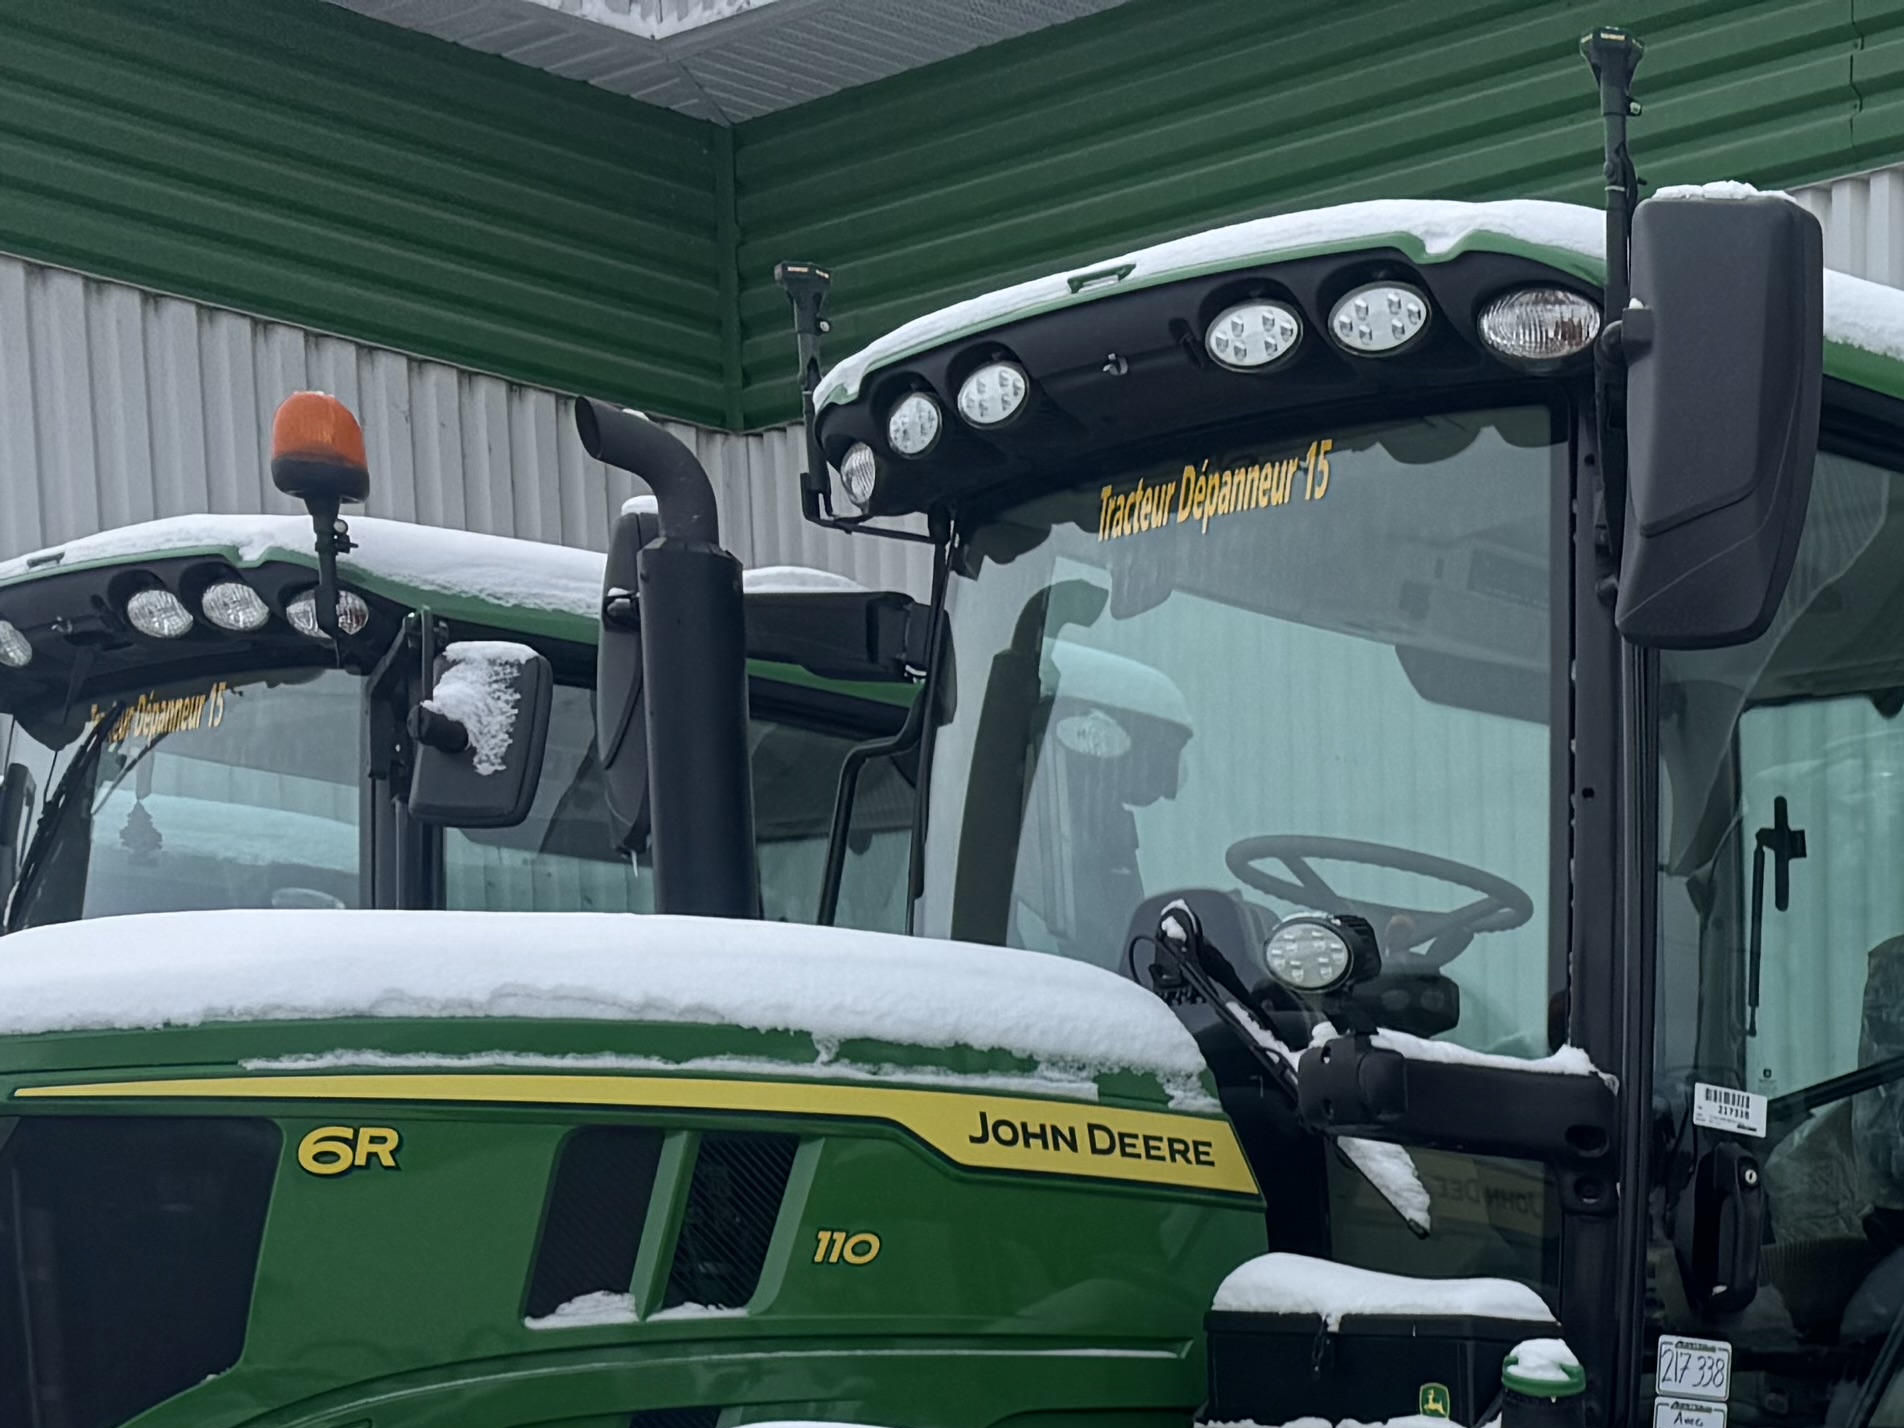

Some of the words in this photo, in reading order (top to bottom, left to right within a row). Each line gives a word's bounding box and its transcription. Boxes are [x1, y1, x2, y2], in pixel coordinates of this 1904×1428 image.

[1098, 478, 1177, 542] Tracteur
[1176, 458, 1298, 535] Dépanneur
[1305, 439, 1333, 500] 15
[208, 682, 227, 728] 15
[298, 1125, 400, 1175] 6R
[968, 1111, 1079, 1154] JOHN
[1087, 1122, 1216, 1168] DEERE
[813, 1230, 881, 1265] 110
